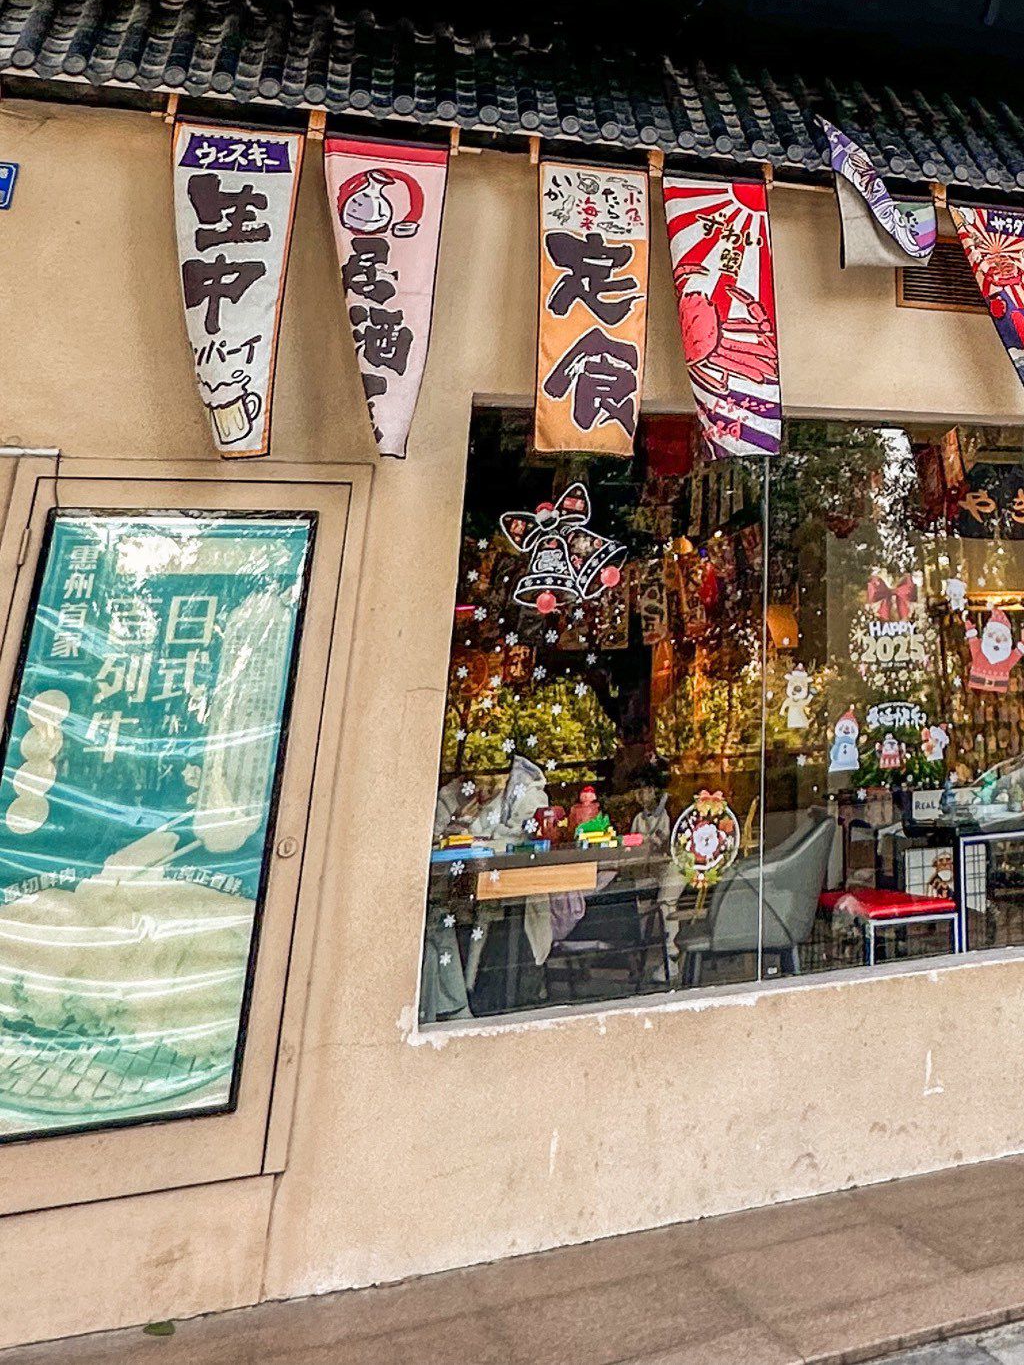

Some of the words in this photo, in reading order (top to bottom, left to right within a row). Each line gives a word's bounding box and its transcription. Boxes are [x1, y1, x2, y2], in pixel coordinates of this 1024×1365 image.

[195, 142, 281, 167] ウィスキー
[181, 173, 271, 335] 生中
[697, 212, 763, 248] ずわい
[543, 231, 639, 438] 定食
[50, 544, 101, 658] 惠州首家
[868, 620, 917, 636] HAPPY
[152, 595, 218, 705] 日式
[861, 635, 925, 662] 2025
